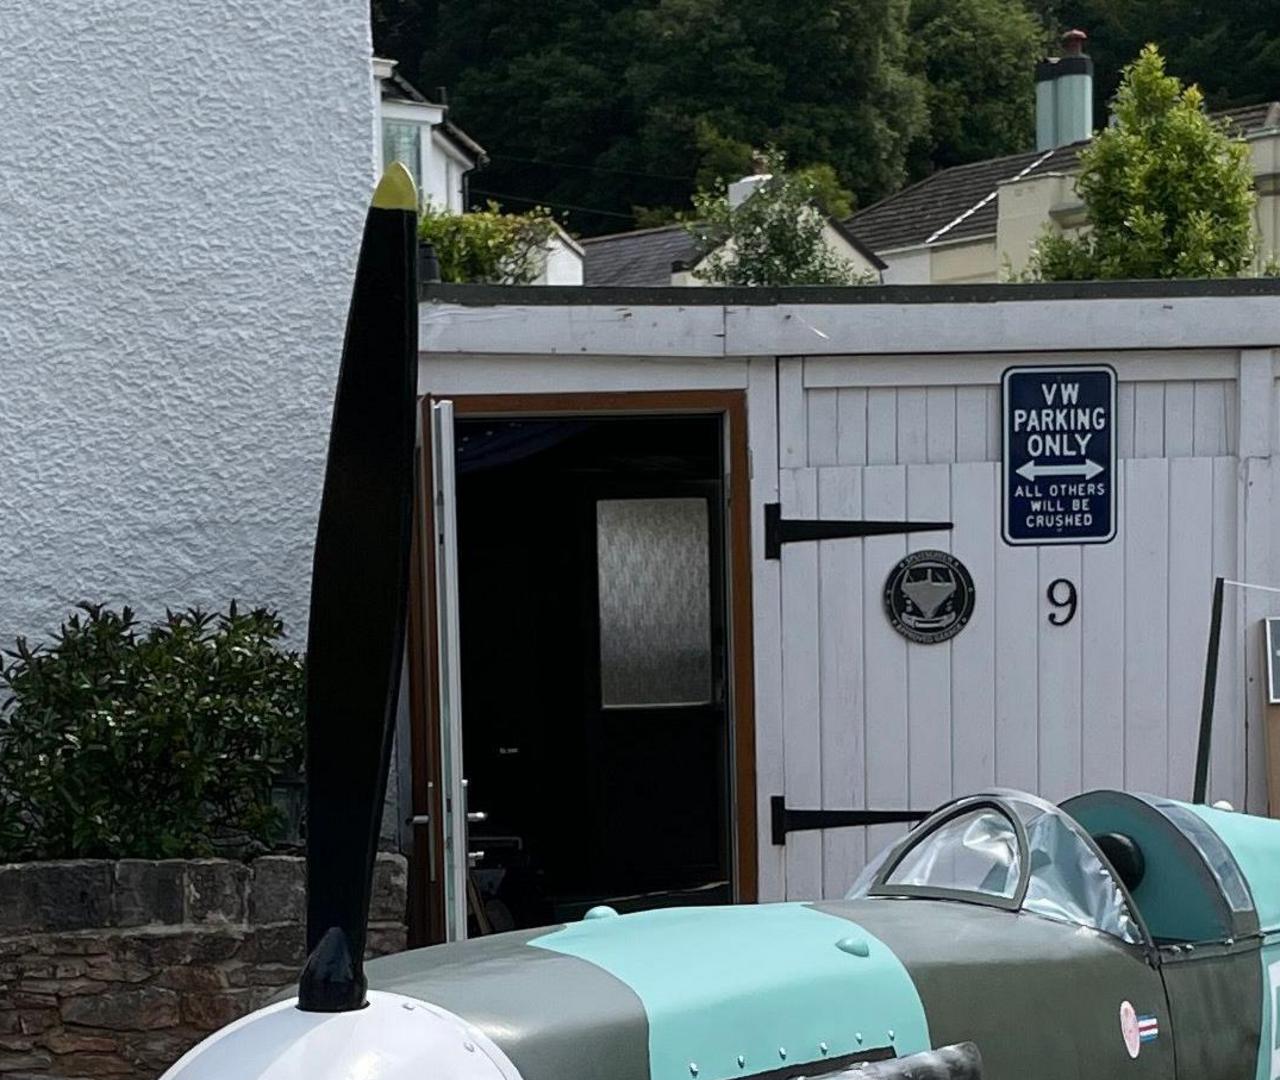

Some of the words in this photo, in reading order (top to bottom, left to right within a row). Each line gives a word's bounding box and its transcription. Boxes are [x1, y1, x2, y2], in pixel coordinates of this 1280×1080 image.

[1041, 383, 1079, 405] VW
[1014, 407, 1105, 431] PARKING
[1027, 433, 1092, 457] ONLY
[1014, 484, 1042, 497] ALL
[1049, 483, 1105, 497] OTHERS
[1030, 500, 1064, 512] WILL
[1072, 498, 1090, 511] BE
[1026, 513, 1093, 528] CRUSHED
[1047, 578, 1077, 626] 9
